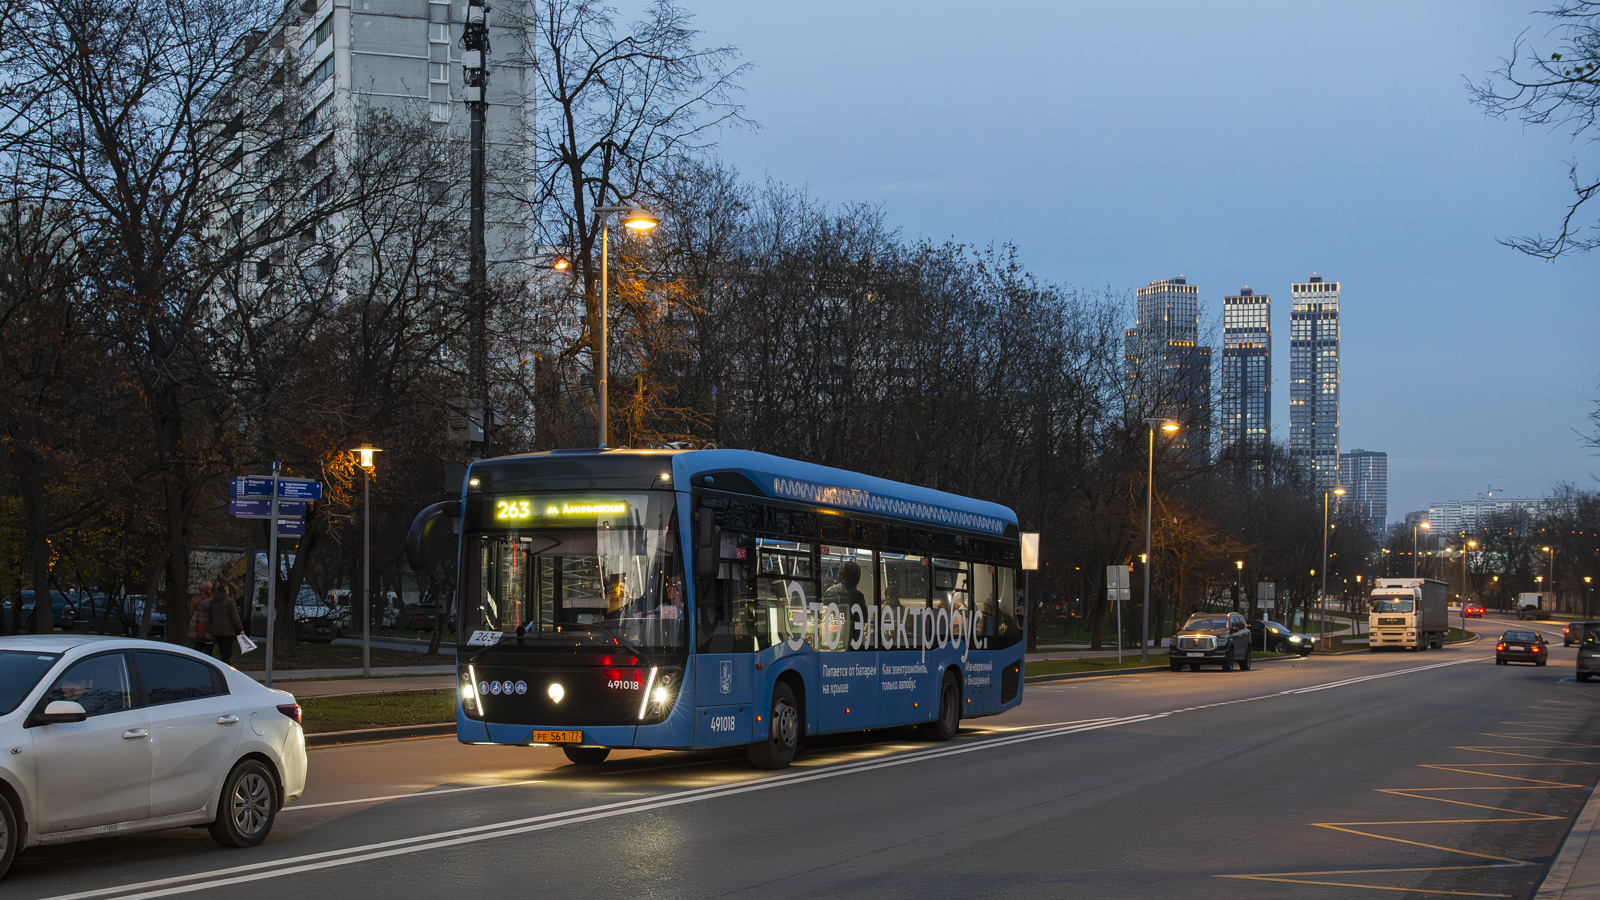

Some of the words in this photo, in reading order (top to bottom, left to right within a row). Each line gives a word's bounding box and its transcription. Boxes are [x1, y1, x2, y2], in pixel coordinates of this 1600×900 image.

[497, 501, 530, 518] 263
[788, 581, 841, 651] Это
[850, 592, 988, 664] электробус.
[475, 632, 496, 642] 263
[822, 664, 848, 678] Питается
[848, 667, 855, 677] от
[855, 663, 877, 679] батареи
[881, 663, 891, 675] Как
[607, 680, 639, 690] 491018
[822, 684, 830, 695] на
[710, 716, 736, 732] 491018
[550, 731, 566, 741] 561
